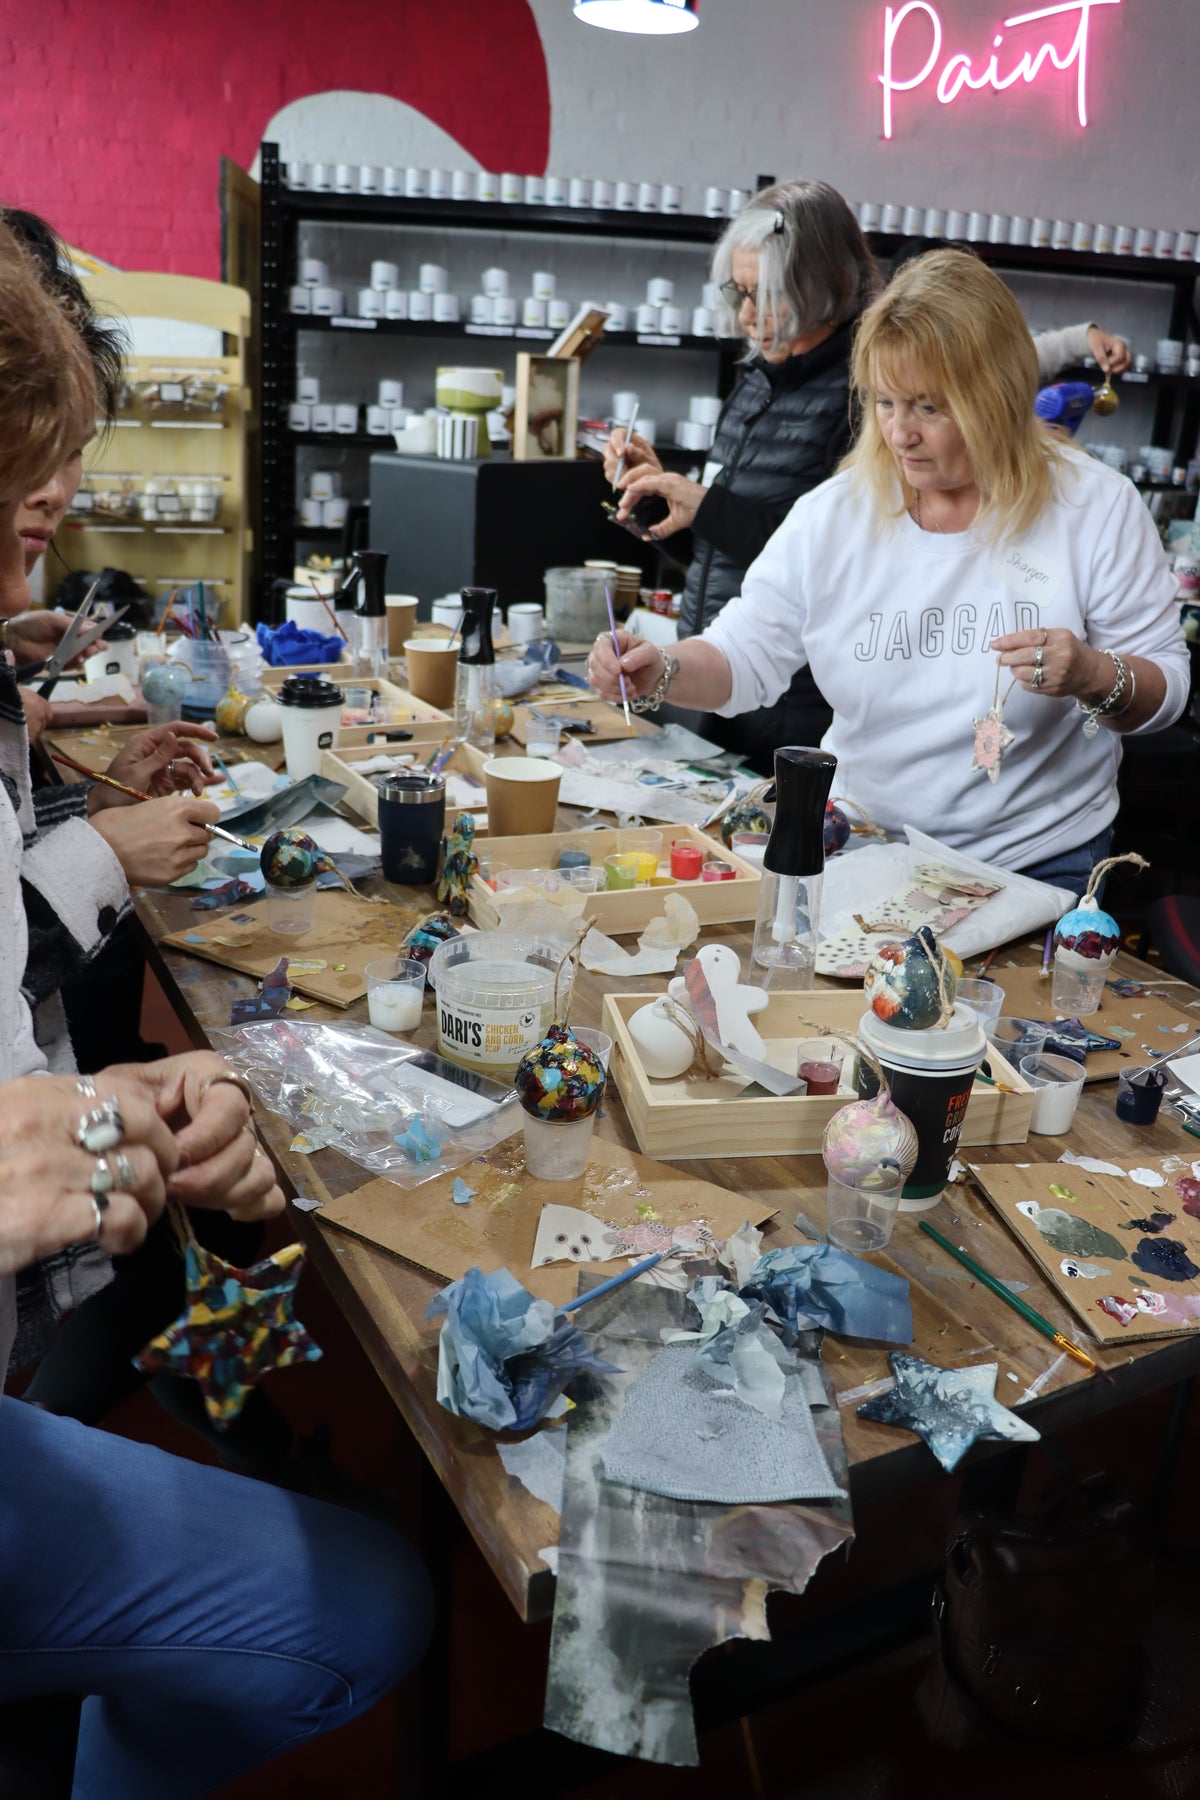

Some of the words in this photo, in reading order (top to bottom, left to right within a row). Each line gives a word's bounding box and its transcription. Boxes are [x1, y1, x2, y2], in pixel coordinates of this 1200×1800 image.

[878, 0, 1121, 139] Paint
[854, 602, 1040, 662] JAGGAD
[441, 1009, 482, 1048] DARI'S
[485, 1023, 519, 1035] CHICKEN
[485, 1034, 501, 1045] AND
[503, 1033, 525, 1045] CORN
